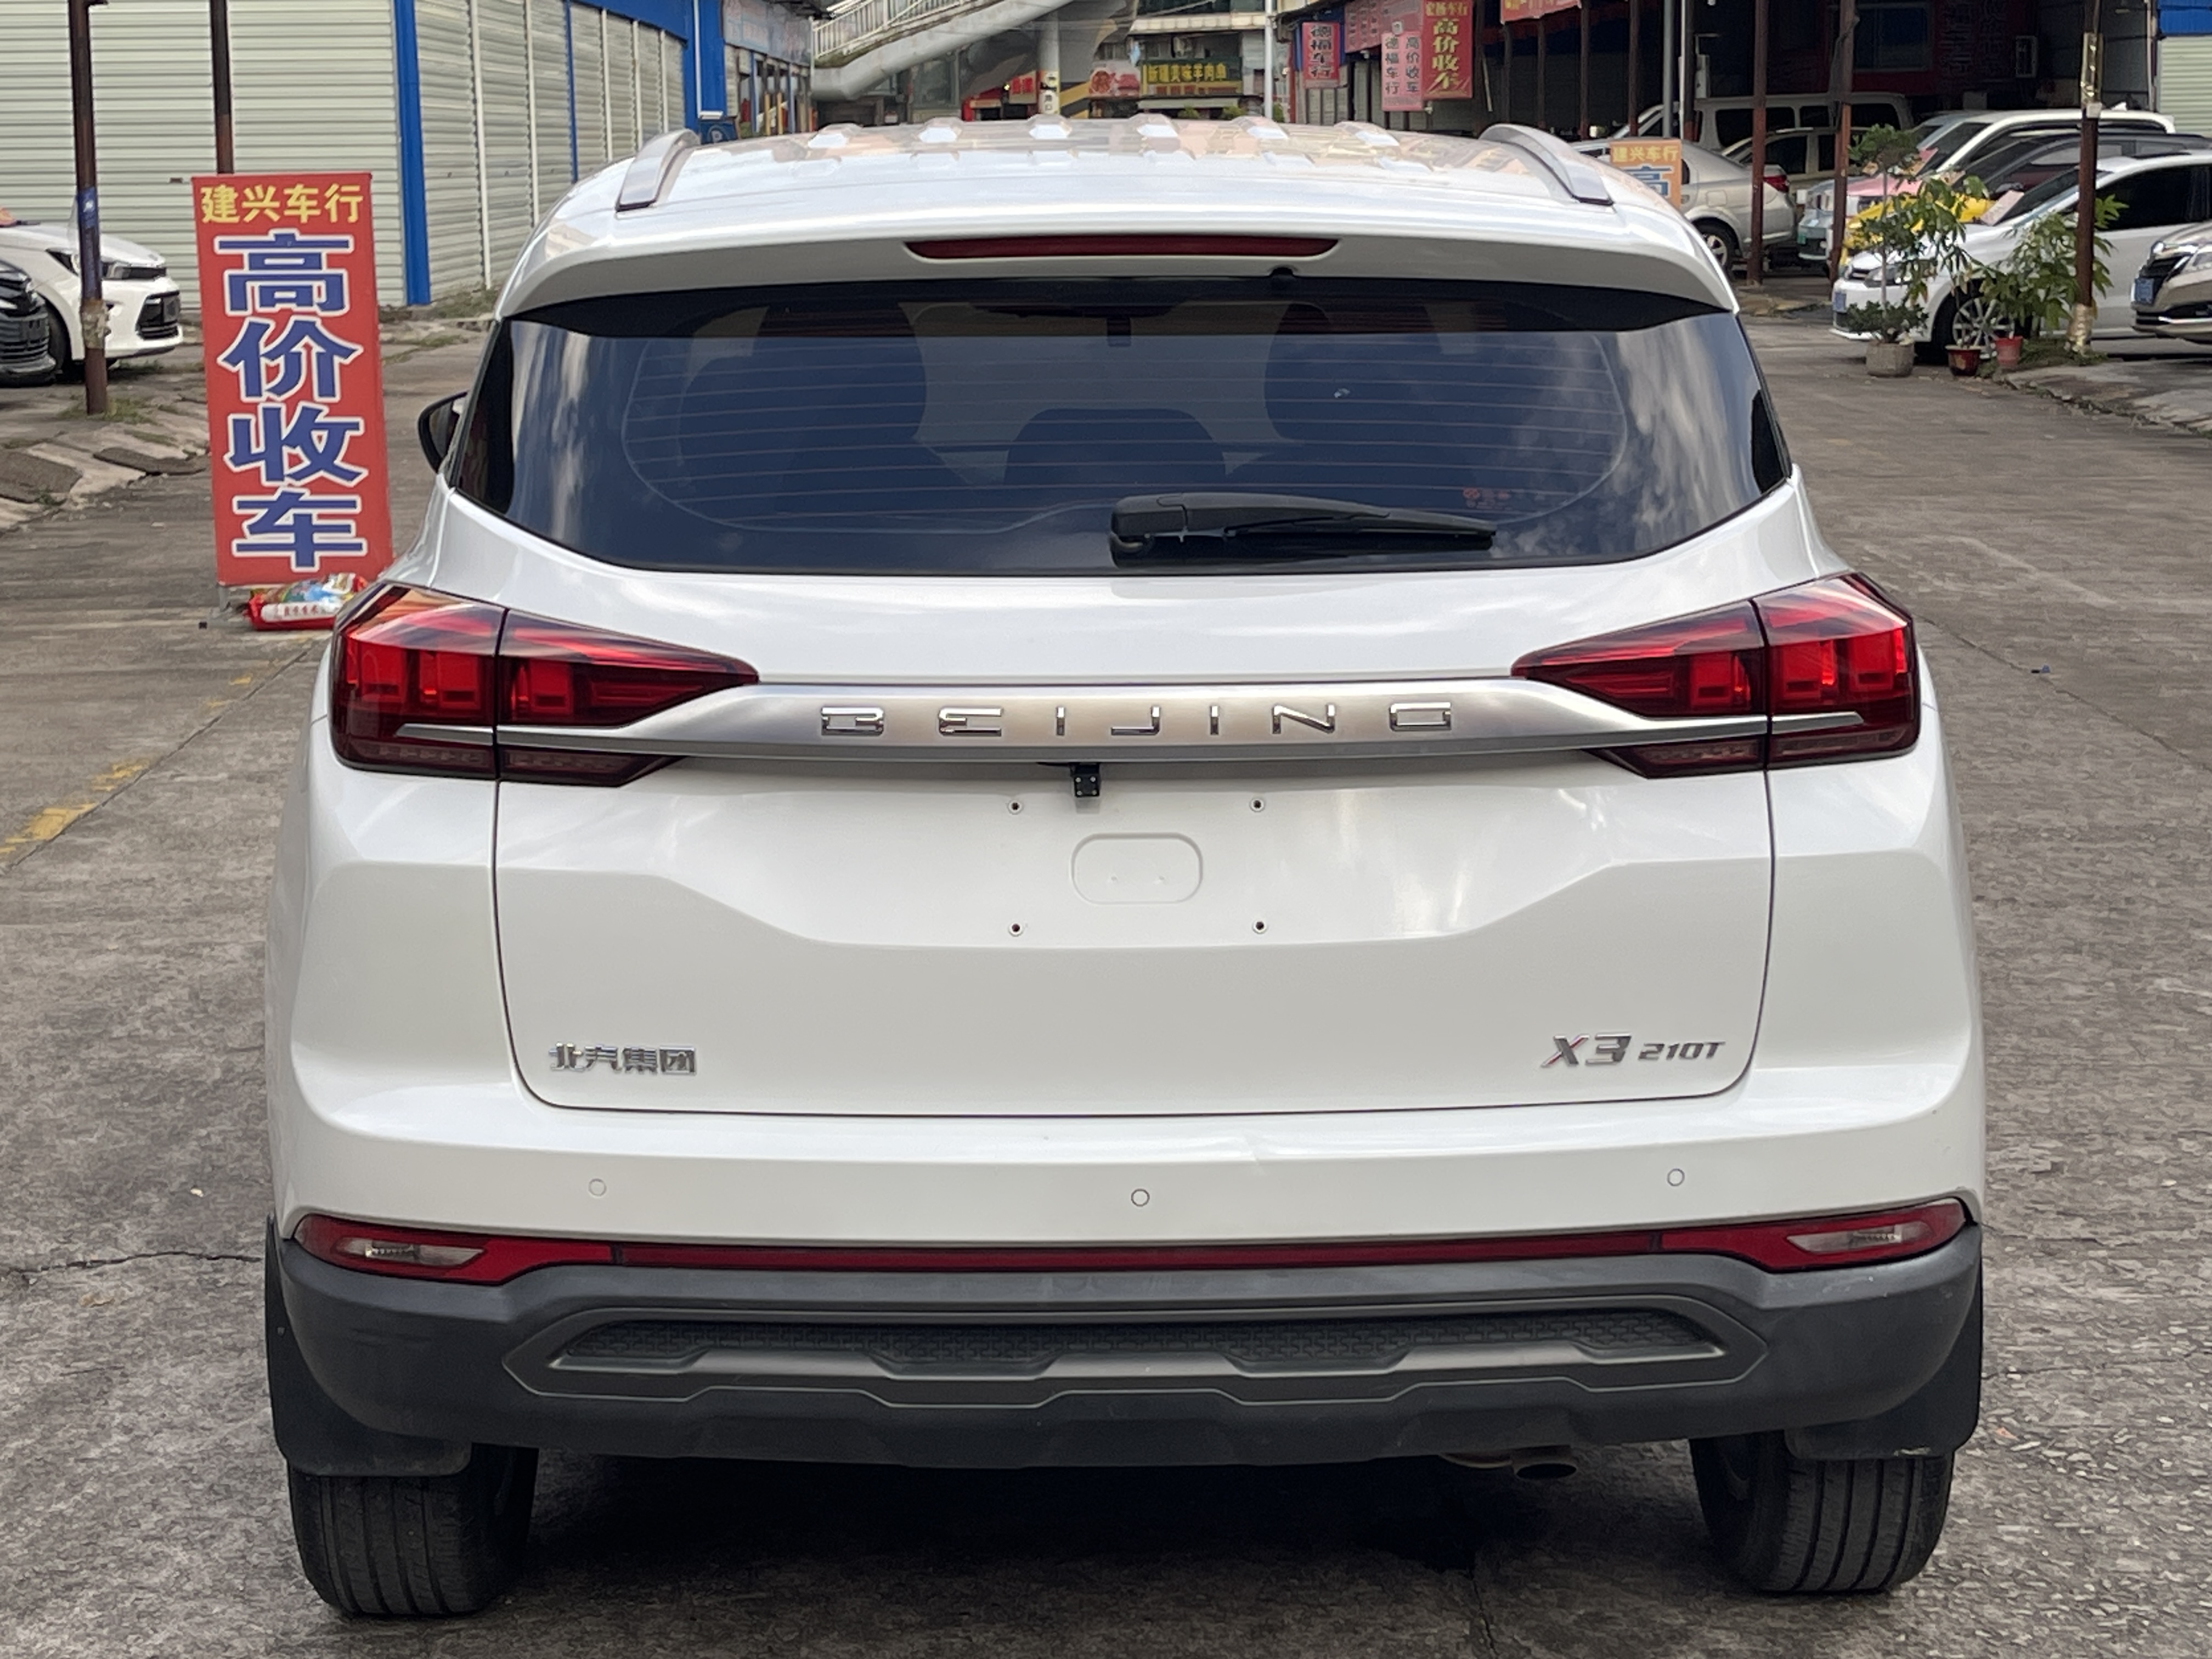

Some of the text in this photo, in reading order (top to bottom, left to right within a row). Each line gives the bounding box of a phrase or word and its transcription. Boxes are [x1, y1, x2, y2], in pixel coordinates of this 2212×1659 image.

[1432, 18, 1460, 89] 高价收车
[1613, 145, 1679, 162] 建兴车行
[200, 183, 363, 224] 建兴车行
[214, 228, 368, 572] 高价收车
[821, 701, 1452, 736] BEIJING
[549, 1042, 697, 1075] 北汽集团
[1541, 1032, 1726, 1068] X3 210T
